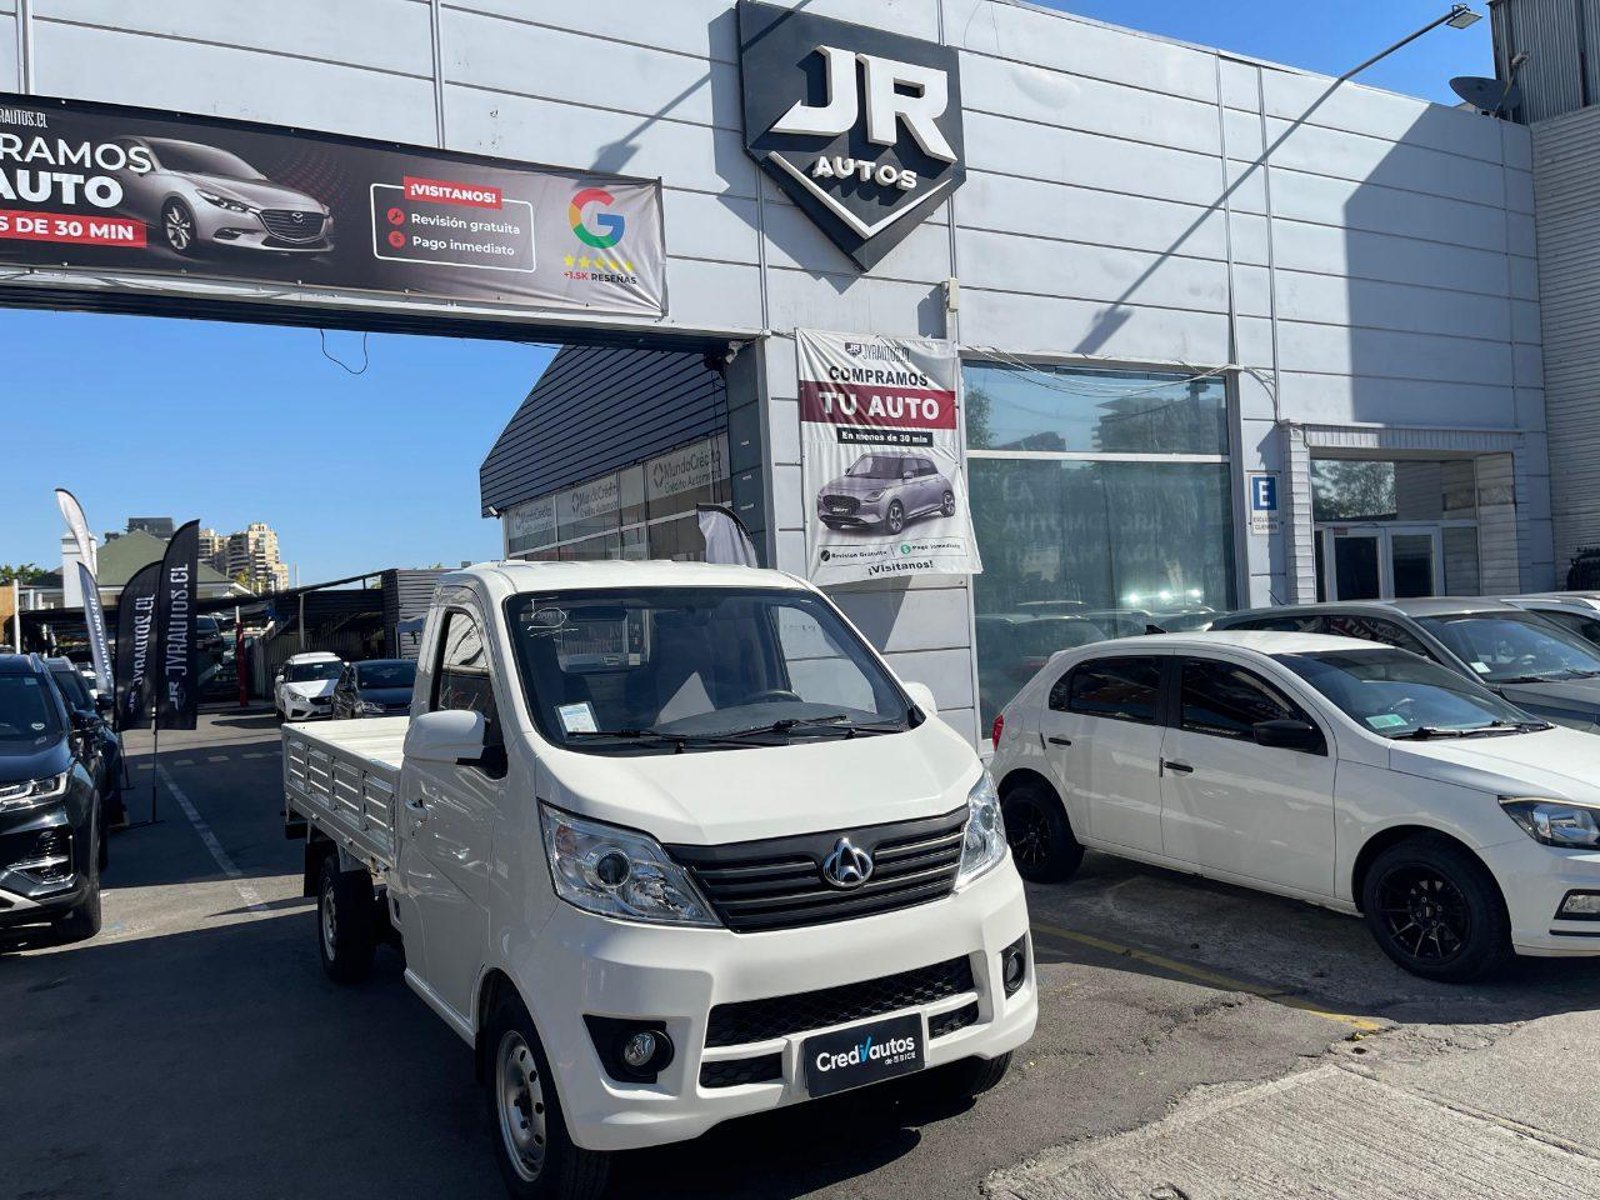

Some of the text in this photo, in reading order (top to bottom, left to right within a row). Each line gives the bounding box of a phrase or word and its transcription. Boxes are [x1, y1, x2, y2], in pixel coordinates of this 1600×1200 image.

[769, 44, 958, 164] JR
[0, 132, 151, 174] RAMOS
[812, 156, 918, 189] AUTOS
[410, 184, 497, 204] ¡VISITANOS!
[15, 217, 49, 235] DE
[54, 220, 83, 238] 30
[89, 223, 134, 241] MIN
[411, 213, 521, 236] Revisión gratuita
[412, 235, 515, 257] Pago inmediato
[564, 271, 638, 285] +1.5K RESEÑAS
[829, 366, 929, 387] COMPRAMOS
[819, 392, 940, 420] TU AUTO
[841, 431, 854, 440] En
[887, 434, 898, 442] de
[900, 435, 911, 443] 30
[664, 450, 721, 479] MundoCrédto
[1258, 480, 1271, 507] E
[868, 560, 934, 575] ¡Visitanos!
[165, 563, 189, 676] JYRAUTOS.CL
[132, 593, 156, 686] JYRAUTOS.CL
